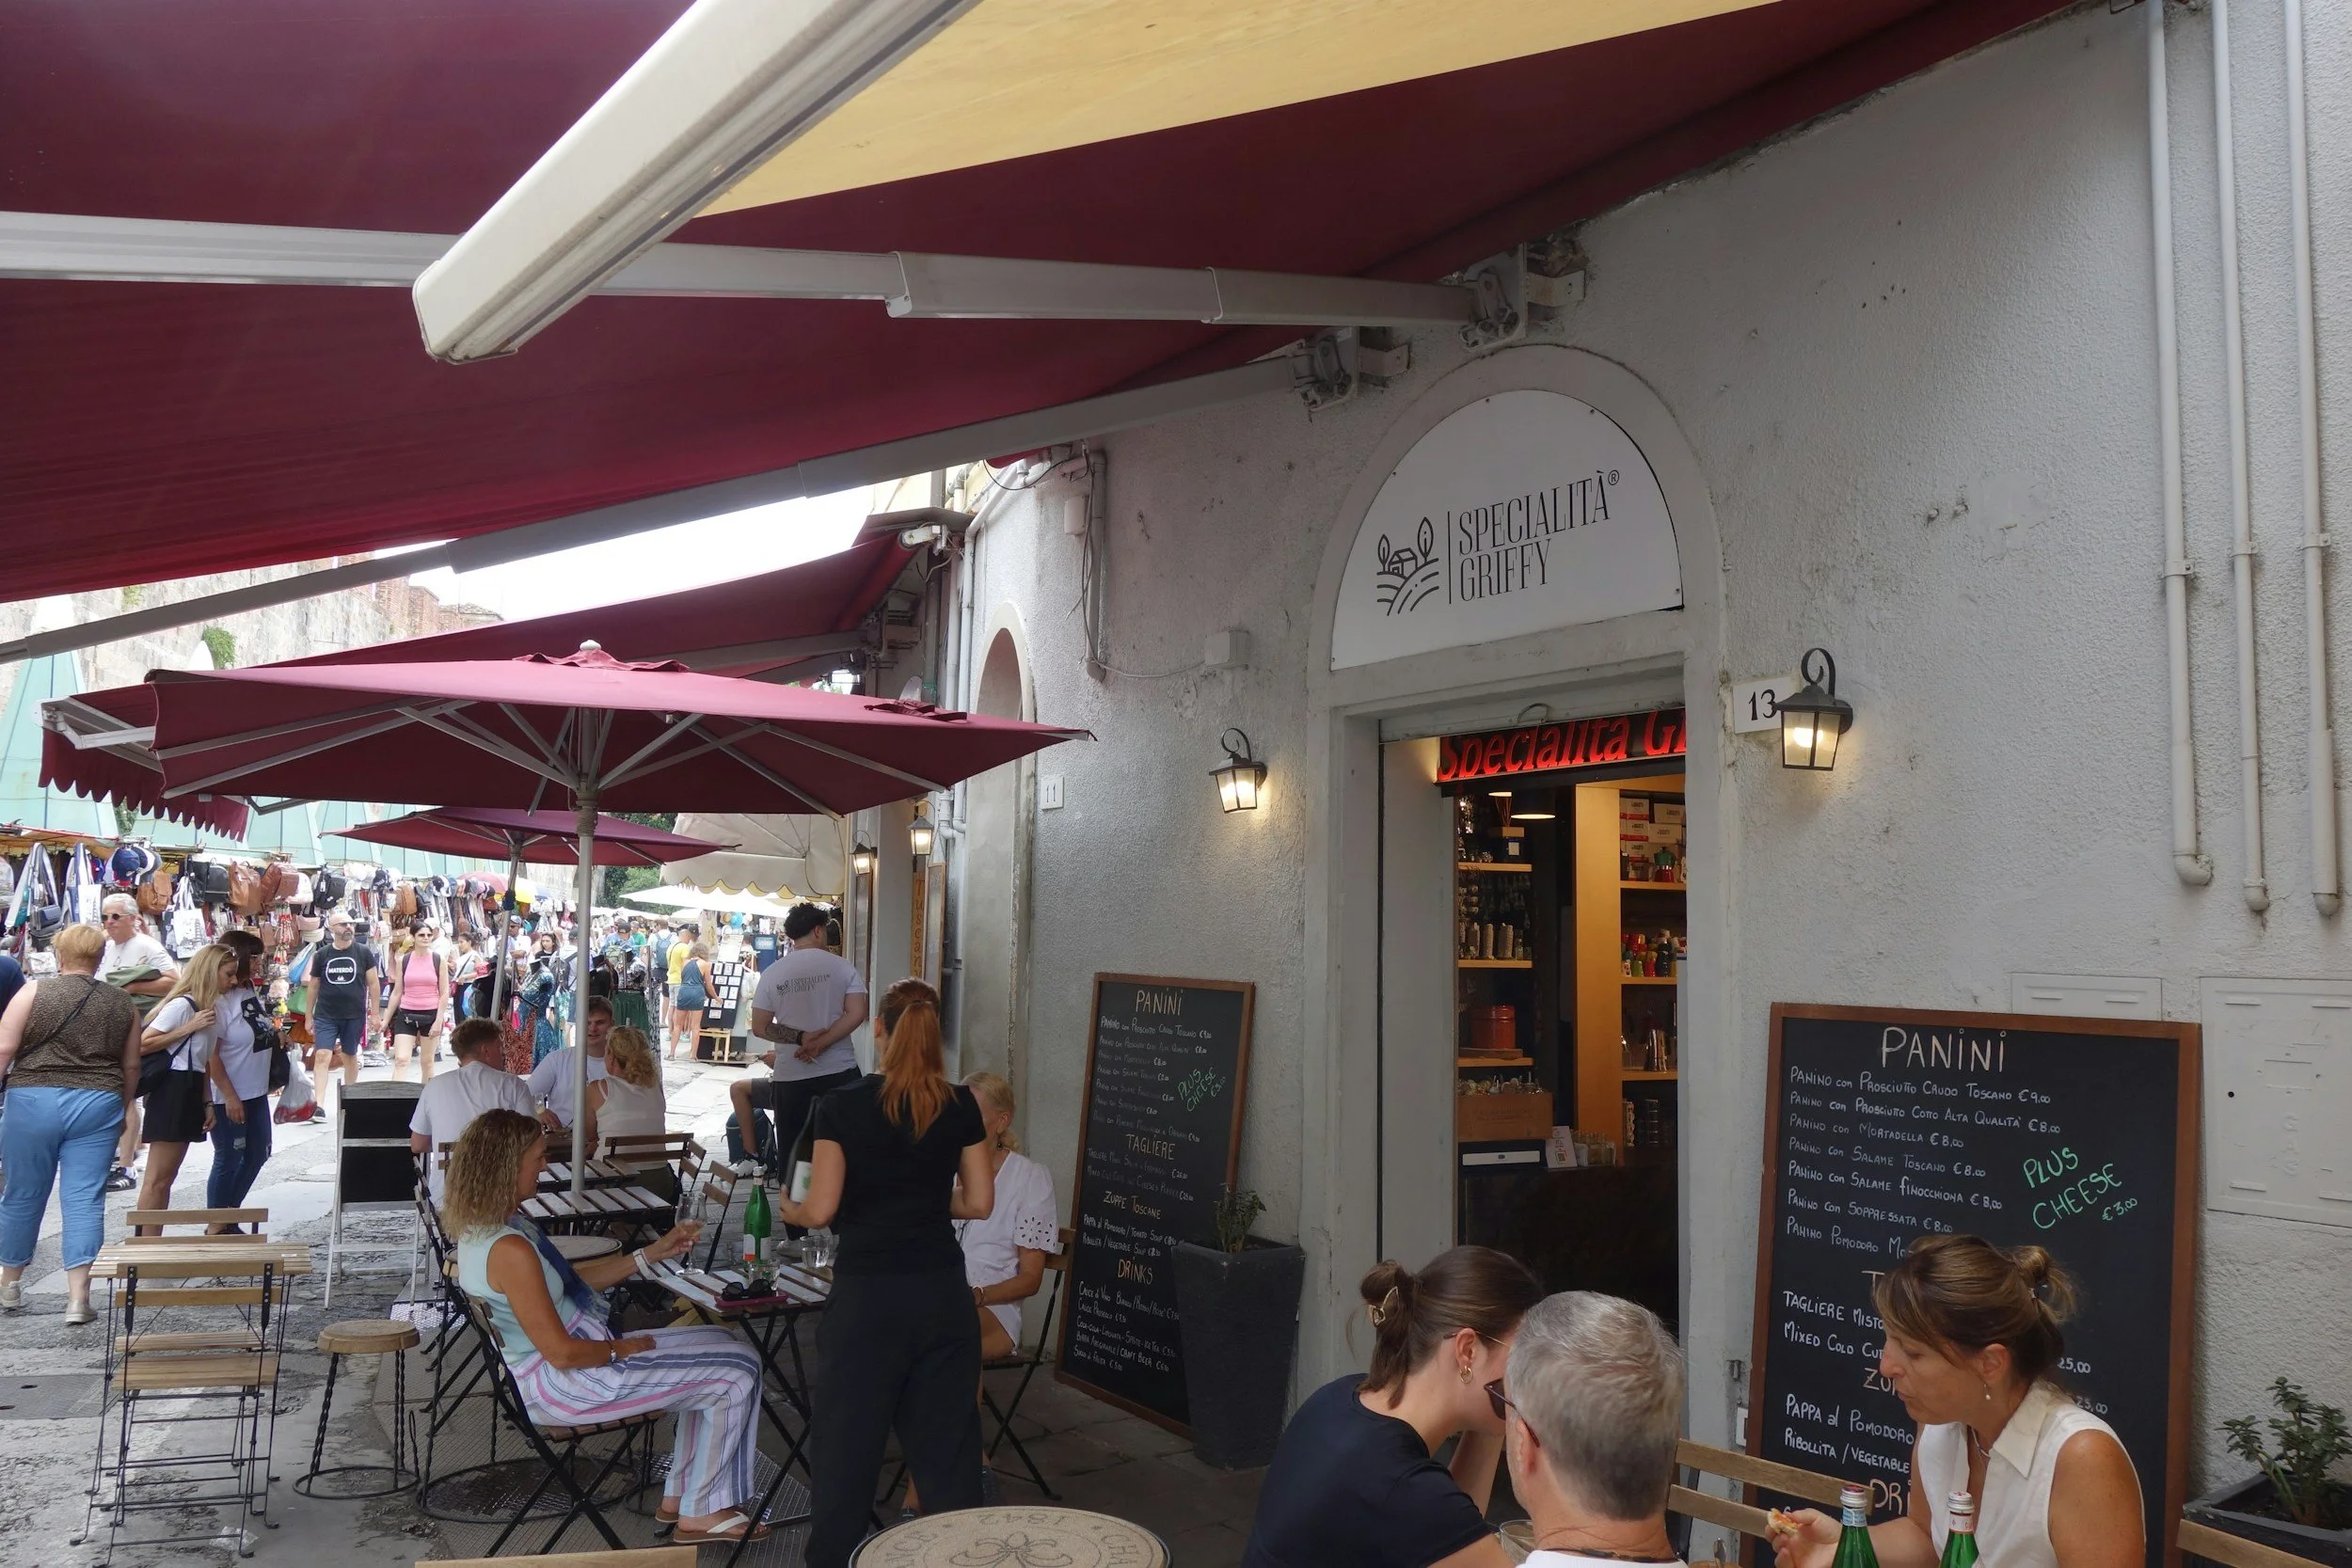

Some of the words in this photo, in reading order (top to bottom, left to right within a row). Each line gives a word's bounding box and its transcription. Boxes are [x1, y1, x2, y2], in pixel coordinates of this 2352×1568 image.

[1460, 539, 1552, 602] GRIFFY
[1748, 689, 1778, 721] 13
[1046, 783, 1057, 803] 11
[1882, 1026, 2008, 1073] PANINI
[1177, 1068, 1201, 1101] PLUS
[1836, 1078, 1852, 1088] con
[1859, 1070, 1916, 1094] PROSCIUTTO
[1922, 1081, 1959, 1097] CRUDO
[1966, 1083, 2012, 1101] TOSCANO
[1829, 1101, 1847, 1112] con
[1855, 1097, 1905, 1117] PROSCIUTTO
[1912, 1105, 1938, 1120] COTTO
[1945, 1108, 1968, 1123] ALTA
[1125, 1133, 1176, 1161] TAGLIERE
[1833, 1123, 1850, 1134] con
[1859, 1121, 1924, 1143] MORTADELLA
[1828, 1146, 1844, 1157] con
[1851, 1146, 1894, 1167] SALAME
[1904, 1154, 1946, 1173] TOSCANO
[2023, 1147, 2078, 1189] PLUS
[1828, 1173, 1845, 1184] con
[1850, 1171, 1891, 1192] SALAME
[2032, 1163, 2122, 1229] CHEESE
[1103, 1191, 1127, 1210] ZUPPE
[1131, 1196, 1162, 1220] TOSCANE
[1824, 1201, 1841, 1213] con
[1831, 1225, 1879, 1253] POMODORO
[1118, 1256, 1153, 1286] DRINKS
[1783, 1291, 1845, 1322] TAGLIERE
[1784, 1321, 1821, 1347] MIXED
[1827, 1334, 1854, 1355] COLD
[1137, 1352, 1152, 1368] BEER
[1786, 1393, 1822, 1423] PAPPA
[1827, 1404, 1840, 1428] al
[1850, 1409, 1915, 1446] POMODORO
[1785, 1427, 1837, 1459] RIBOLLITA
